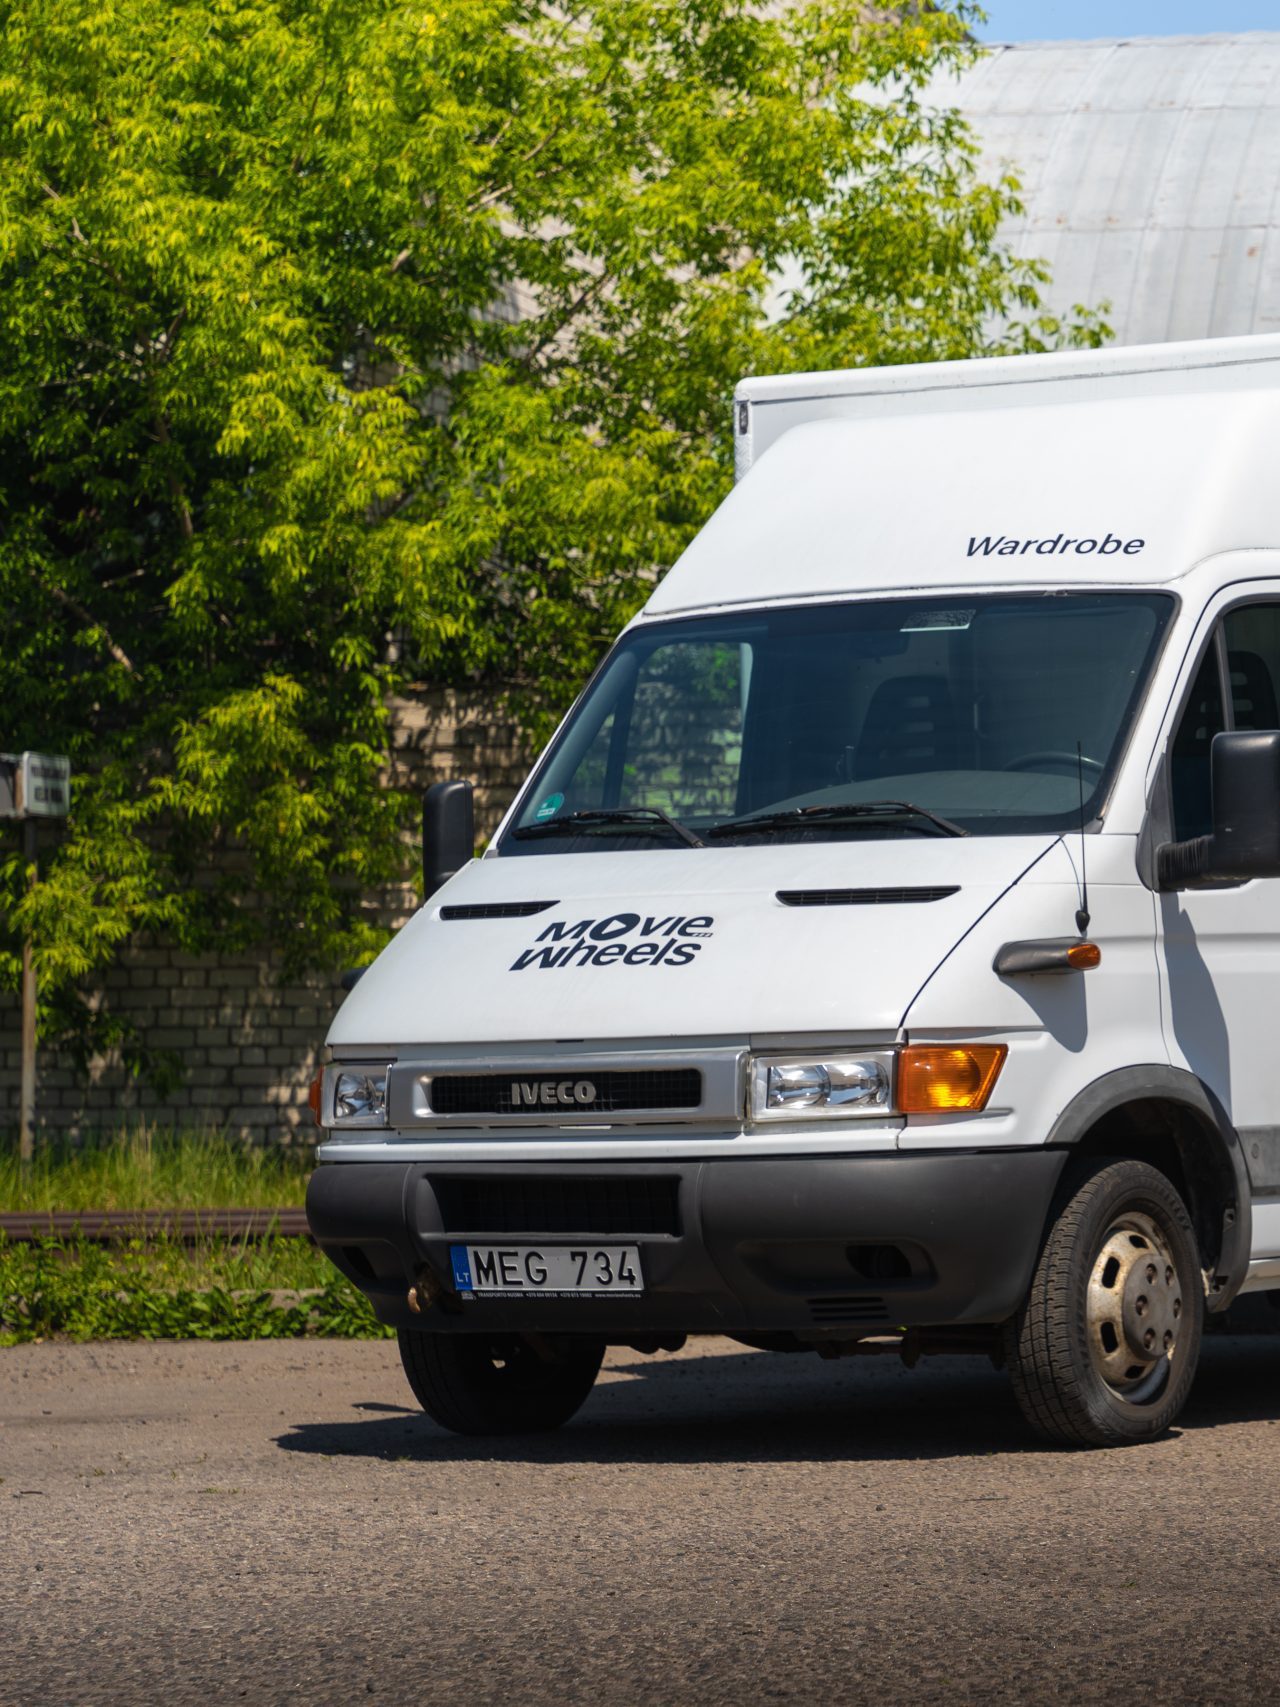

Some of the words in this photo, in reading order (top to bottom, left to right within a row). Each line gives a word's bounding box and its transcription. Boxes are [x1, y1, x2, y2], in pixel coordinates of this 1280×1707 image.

[966, 533, 1145, 557] Wardrobe
[508, 937, 702, 972] Wheels
[511, 1080, 597, 1105] IVECO
[456, 1272, 470, 1283] LT
[473, 1250, 548, 1286] MEG
[570, 1251, 636, 1286] 734
